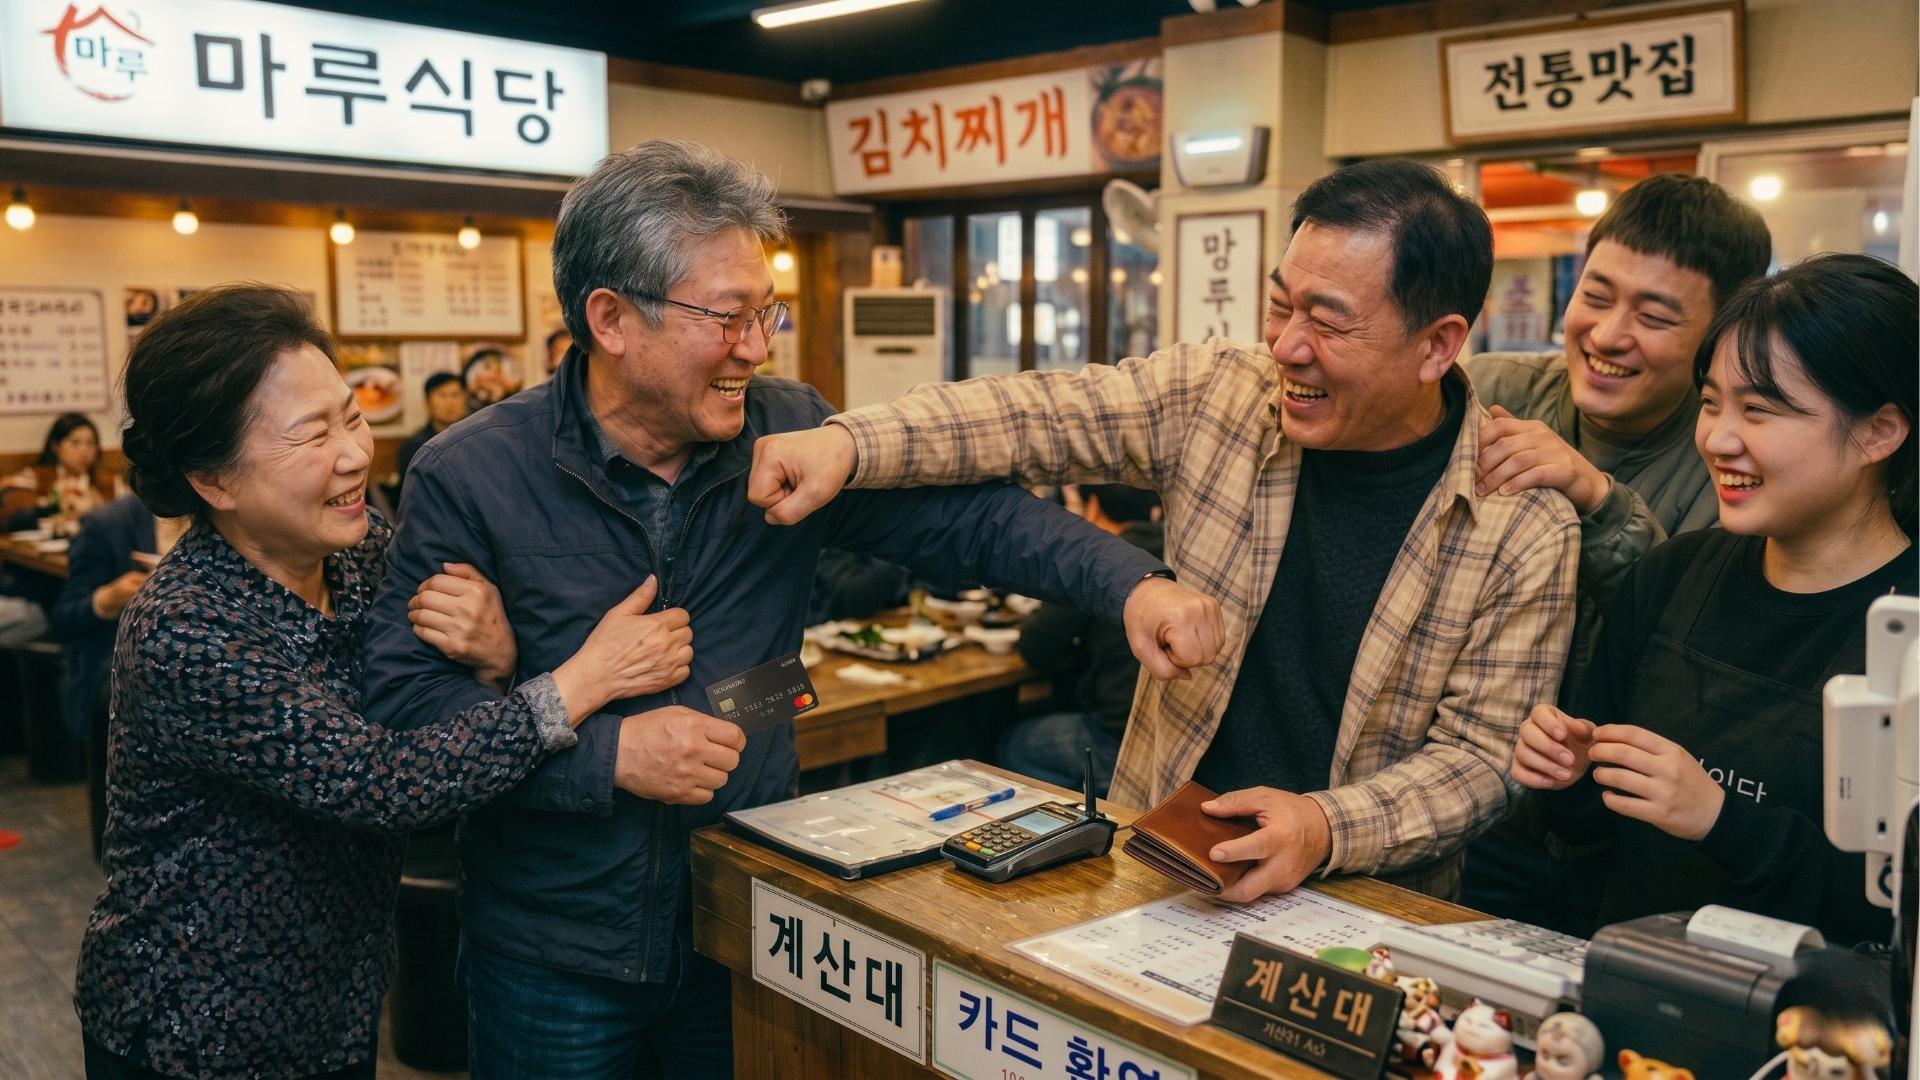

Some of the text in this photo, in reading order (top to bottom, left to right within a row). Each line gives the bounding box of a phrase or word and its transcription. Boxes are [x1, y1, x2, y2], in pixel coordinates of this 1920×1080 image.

[74, 36, 149, 82] 마루
[193, 31, 565, 145] 마루식당
[1483, 33, 1697, 113] 전통맛집
[848, 86, 1070, 179] 김치찌개
[1699, 758, 1767, 804] 이다
[768, 910, 904, 1028] 계산대
[1245, 957, 1374, 1037] 계산대
[958, 990, 1042, 1070] 카드
